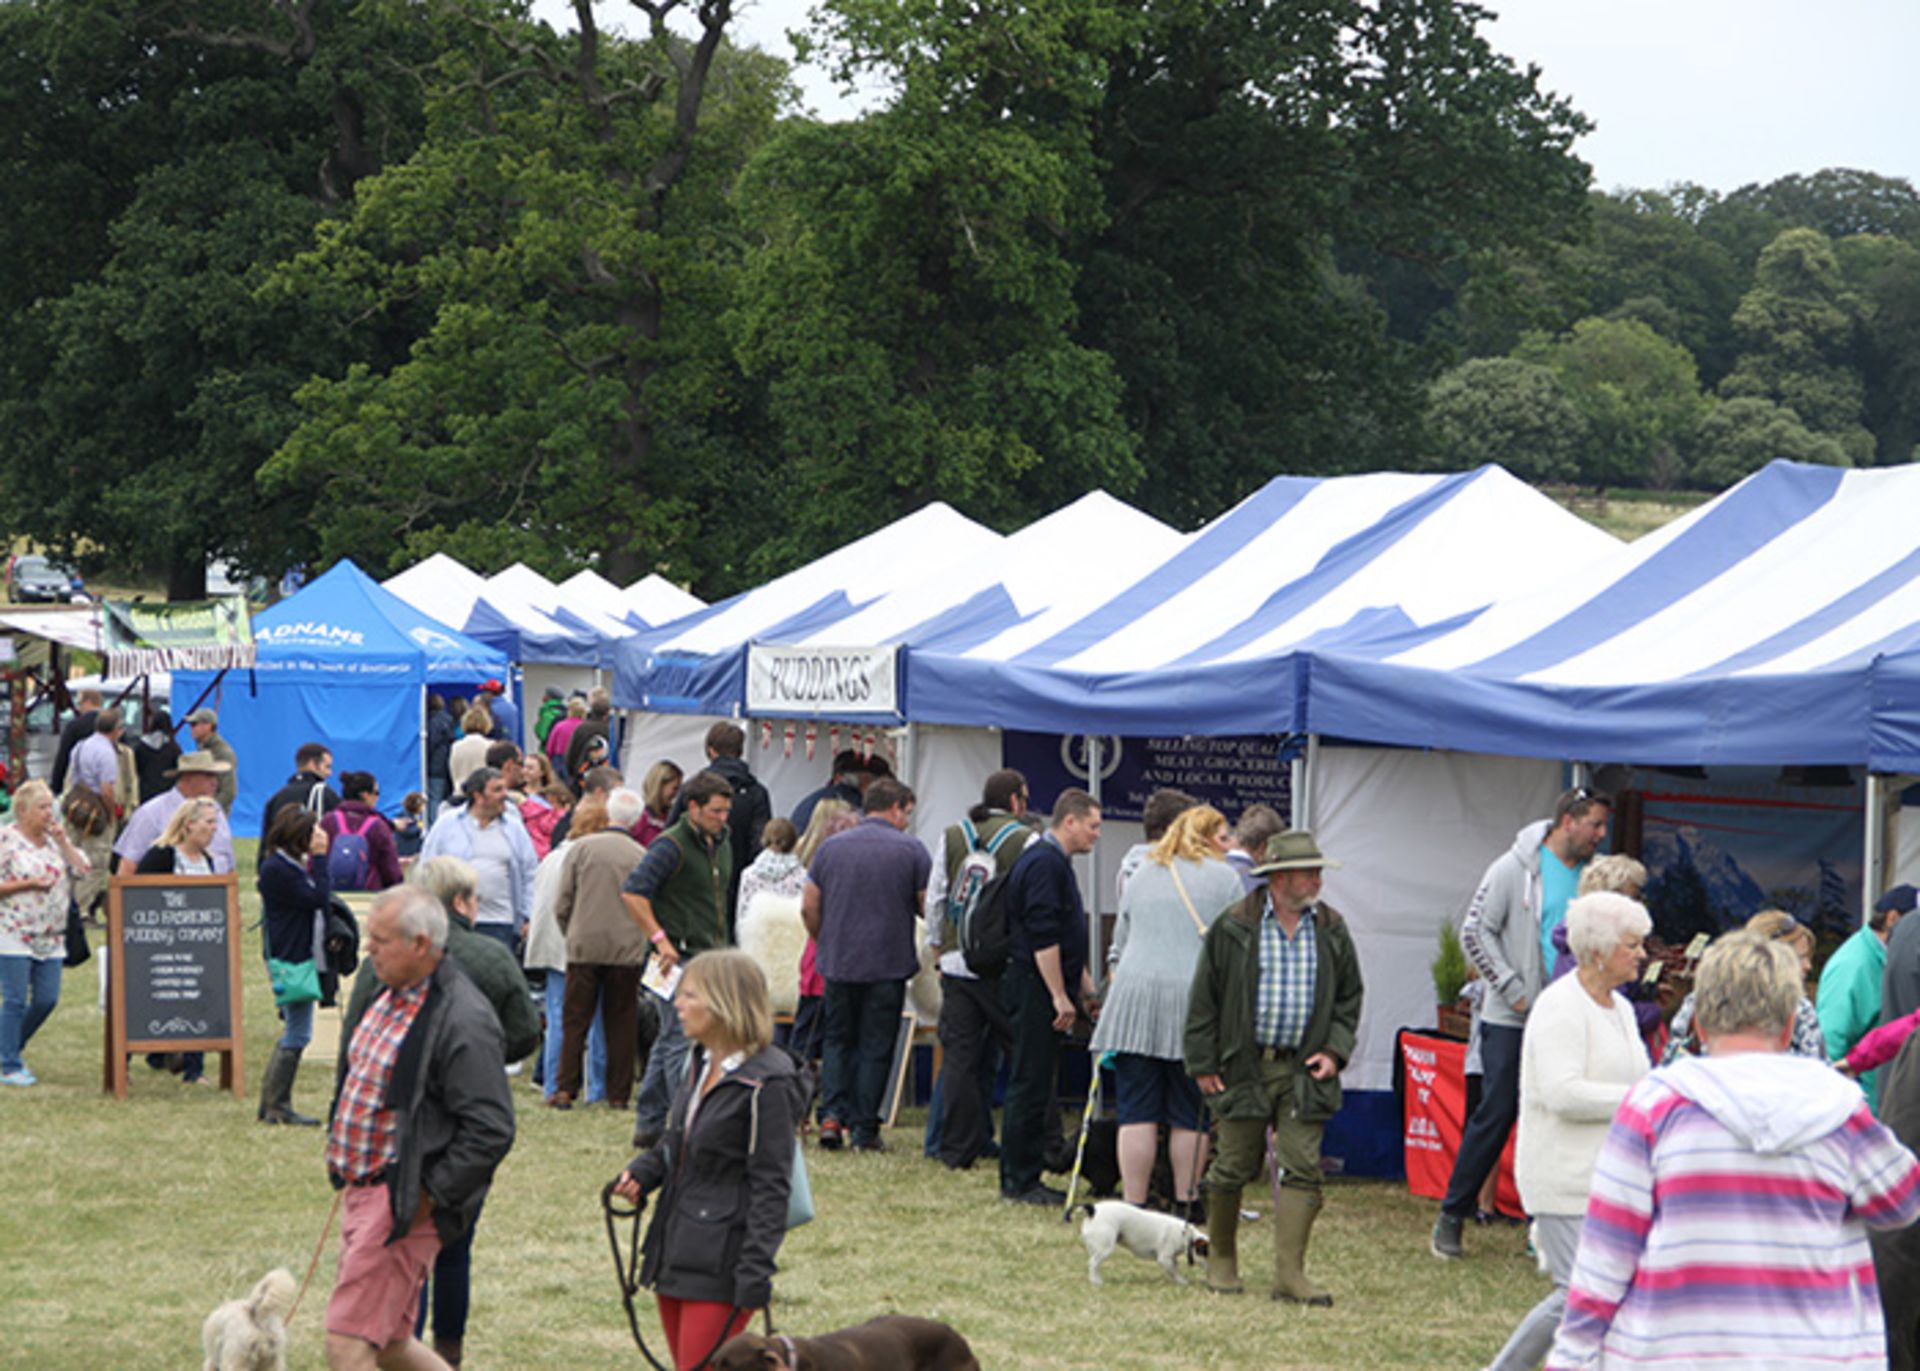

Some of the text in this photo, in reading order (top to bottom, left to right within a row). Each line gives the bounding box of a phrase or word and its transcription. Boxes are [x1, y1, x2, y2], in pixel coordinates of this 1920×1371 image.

[254, 622, 365, 646] ADNAMS
[299, 660, 316, 670] the
[770, 655, 872, 702] PUDDINGS
[1147, 738, 1207, 752] SELLING
[1208, 739, 1237, 754] TOP
[1154, 753, 1195, 767] MEAT
[1141, 769, 1292, 788] AND LOCAL PRODUC
[162, 890, 187, 907] THE
[132, 909, 224, 925] OLD FASHIONED
[178, 926, 226, 944] COMPANY
